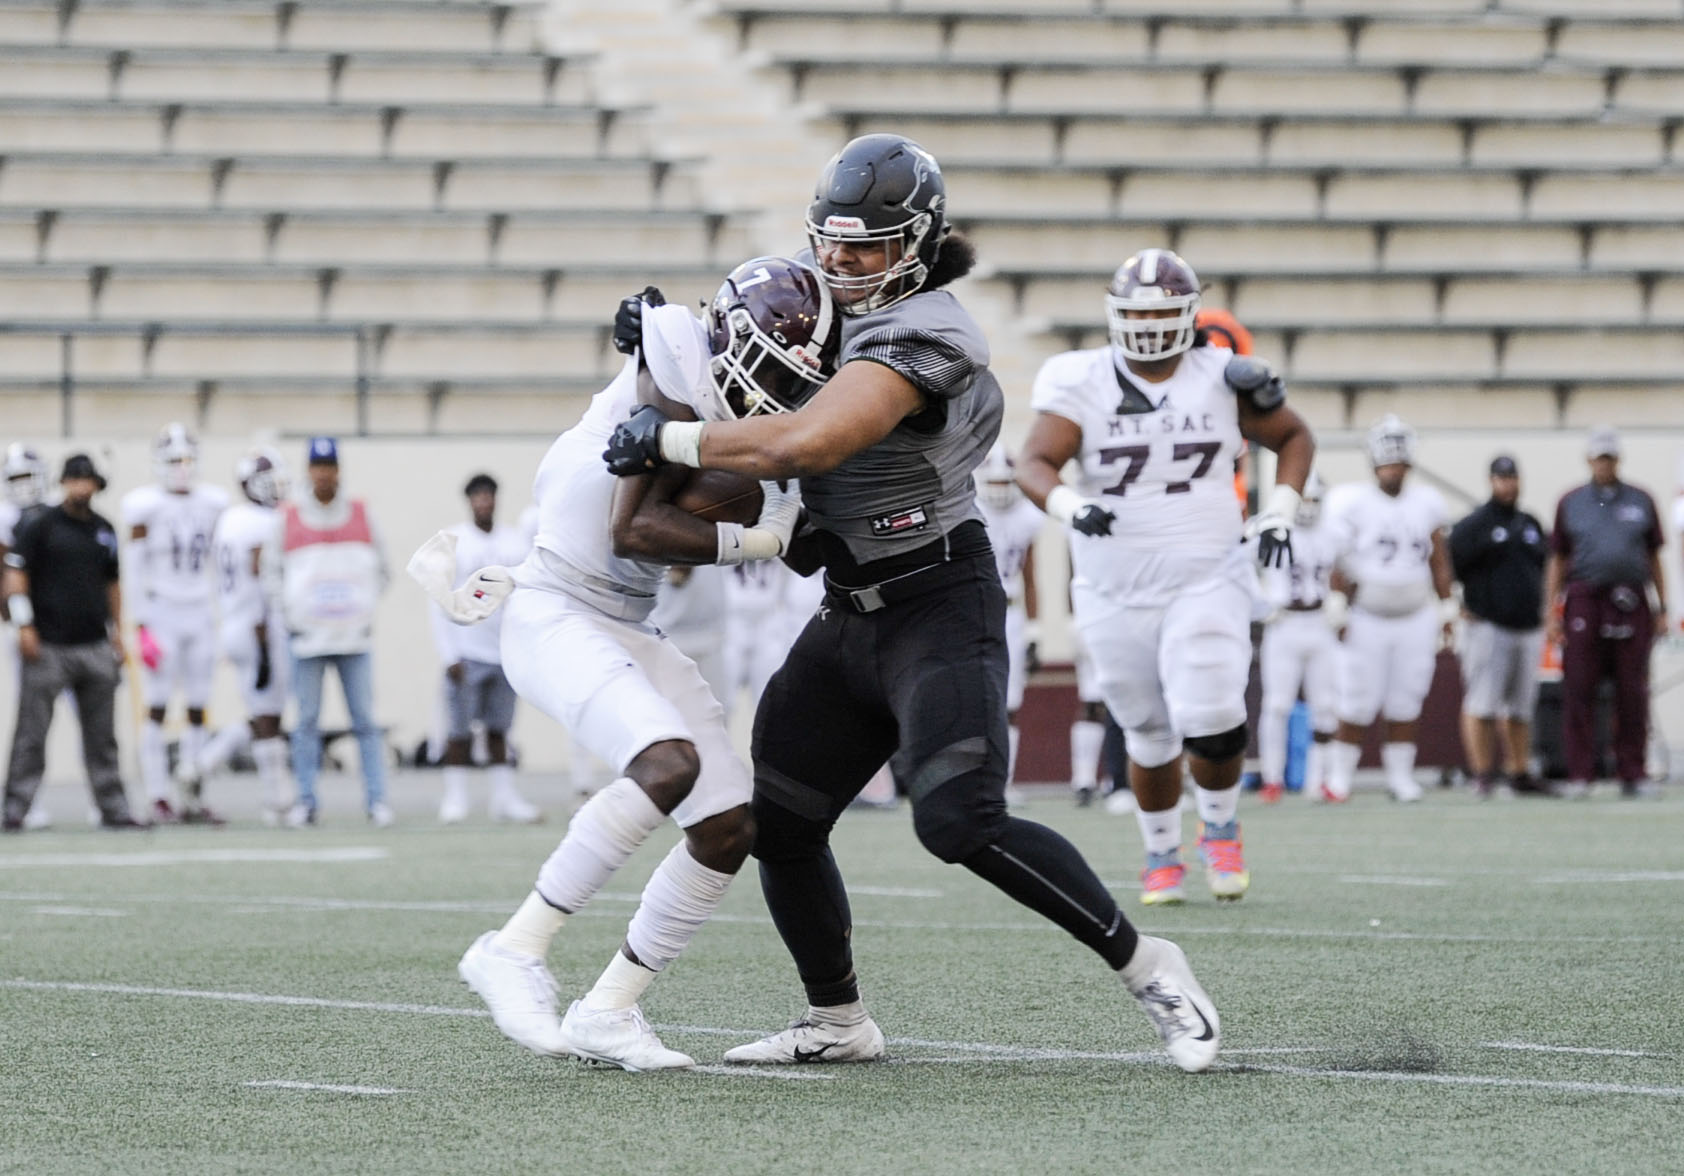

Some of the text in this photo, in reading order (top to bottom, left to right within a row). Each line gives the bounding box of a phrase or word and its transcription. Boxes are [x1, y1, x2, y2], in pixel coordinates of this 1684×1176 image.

[828, 219, 859, 229] Riddell
[735, 267, 772, 294] 7
[1162, 413, 1214, 433] SAC
[1099, 442, 1222, 497] 77
